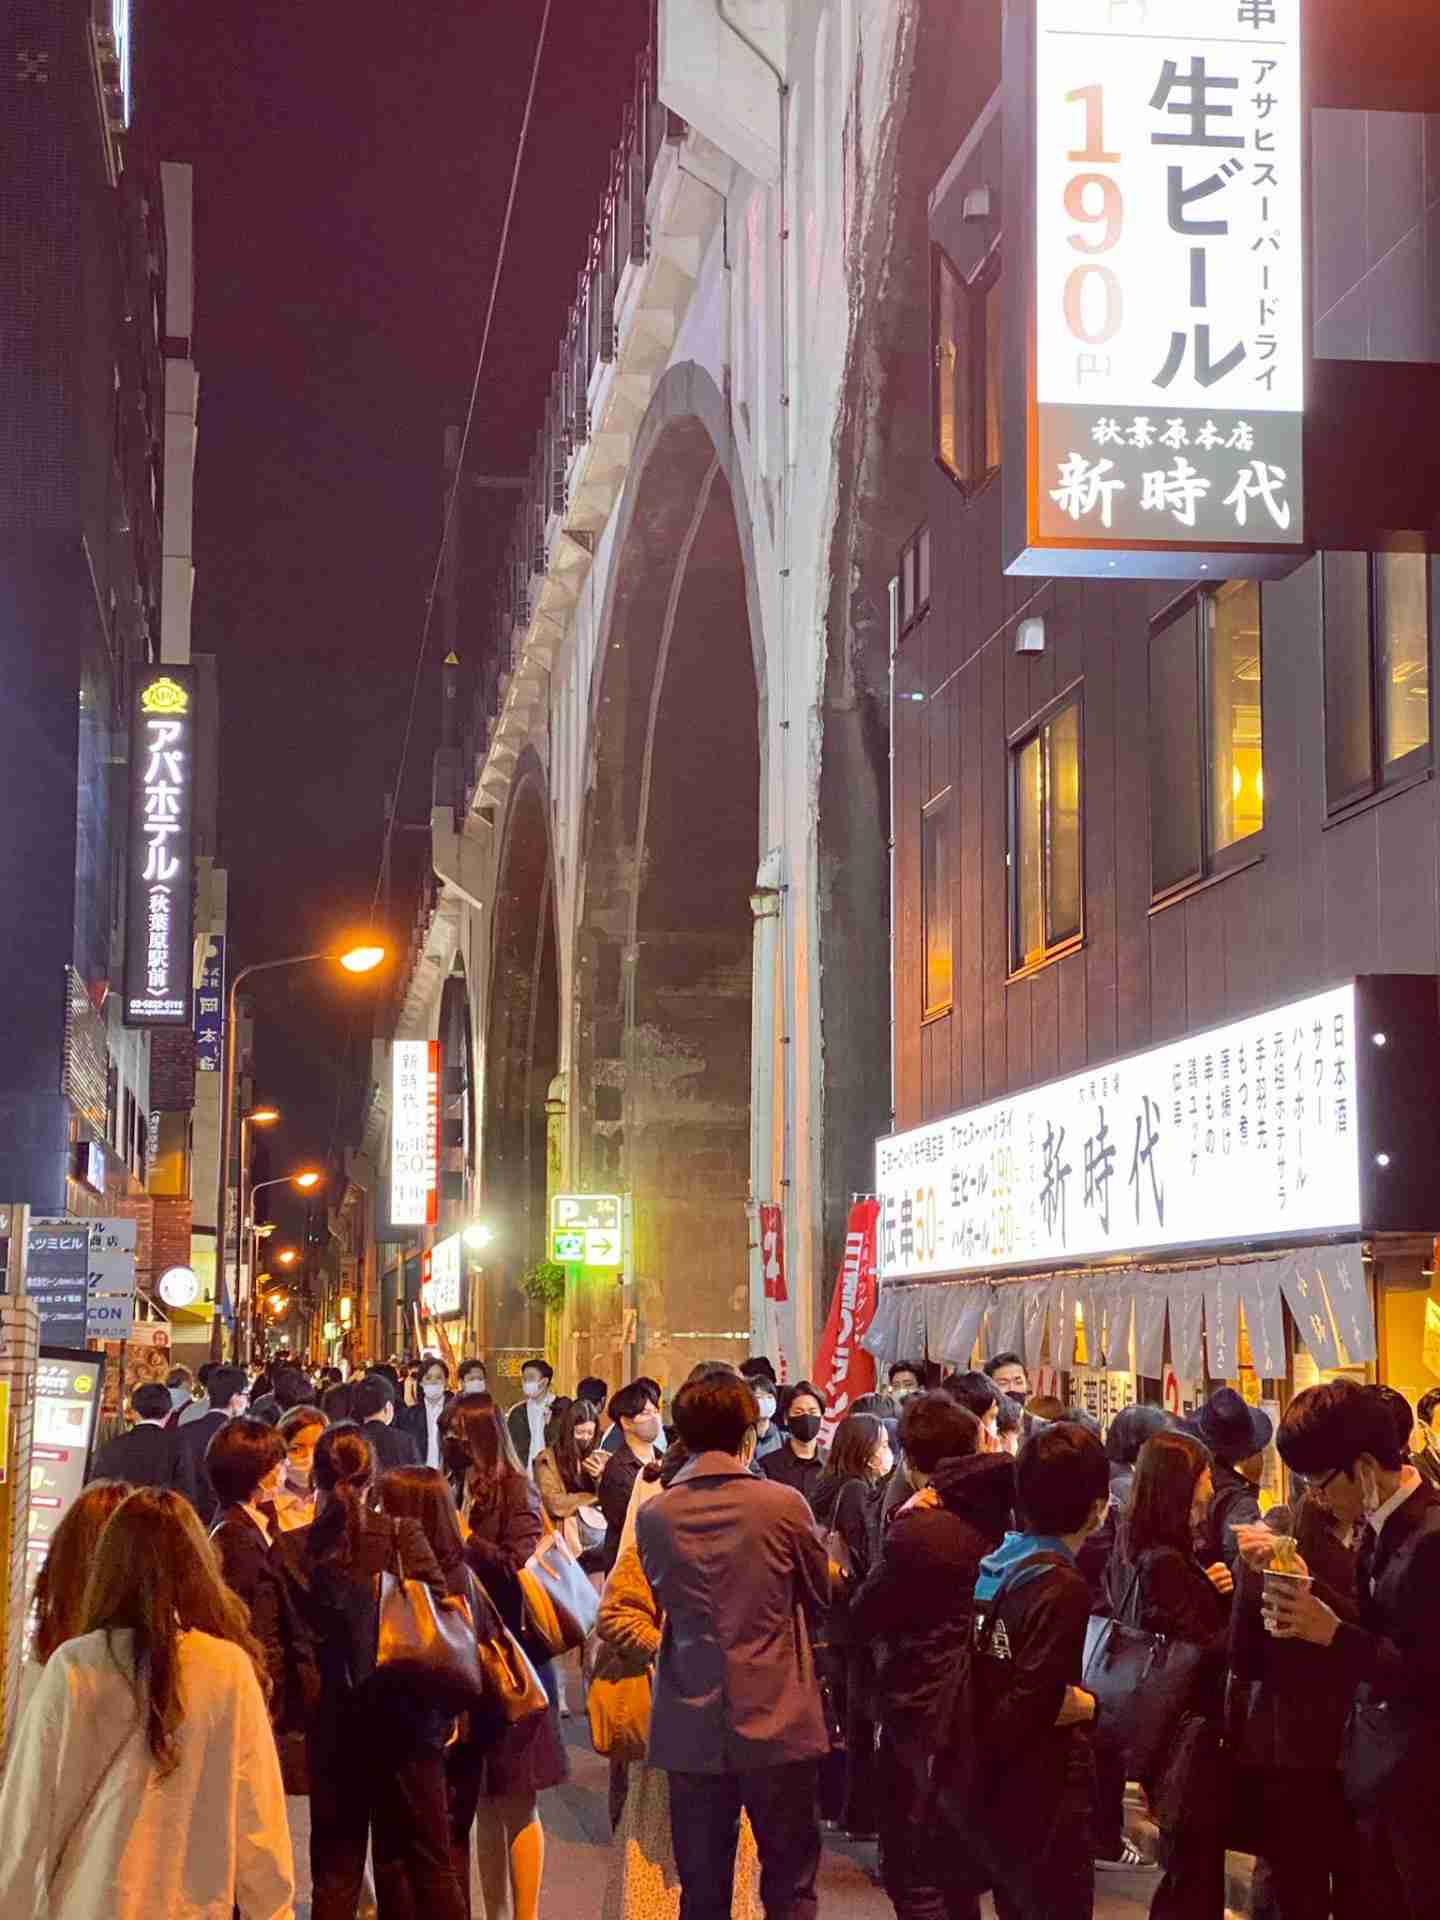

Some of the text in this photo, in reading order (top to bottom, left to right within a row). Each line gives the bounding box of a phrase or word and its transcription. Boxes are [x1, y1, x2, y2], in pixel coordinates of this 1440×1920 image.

[1148, 56, 1247, 388] 生ビール
[1250, 59, 1281, 391] アサヒスーパードライ
[1049, 452, 1291, 529] 新時代
[1091, 416, 1255, 451] 秋葉原本店
[142, 719, 182, 881] アパホテル
[1312, 1019, 1324, 1126] サワー
[1333, 1013, 1347, 1133] 日本酒
[1040, 1096, 1165, 1249] 新時代
